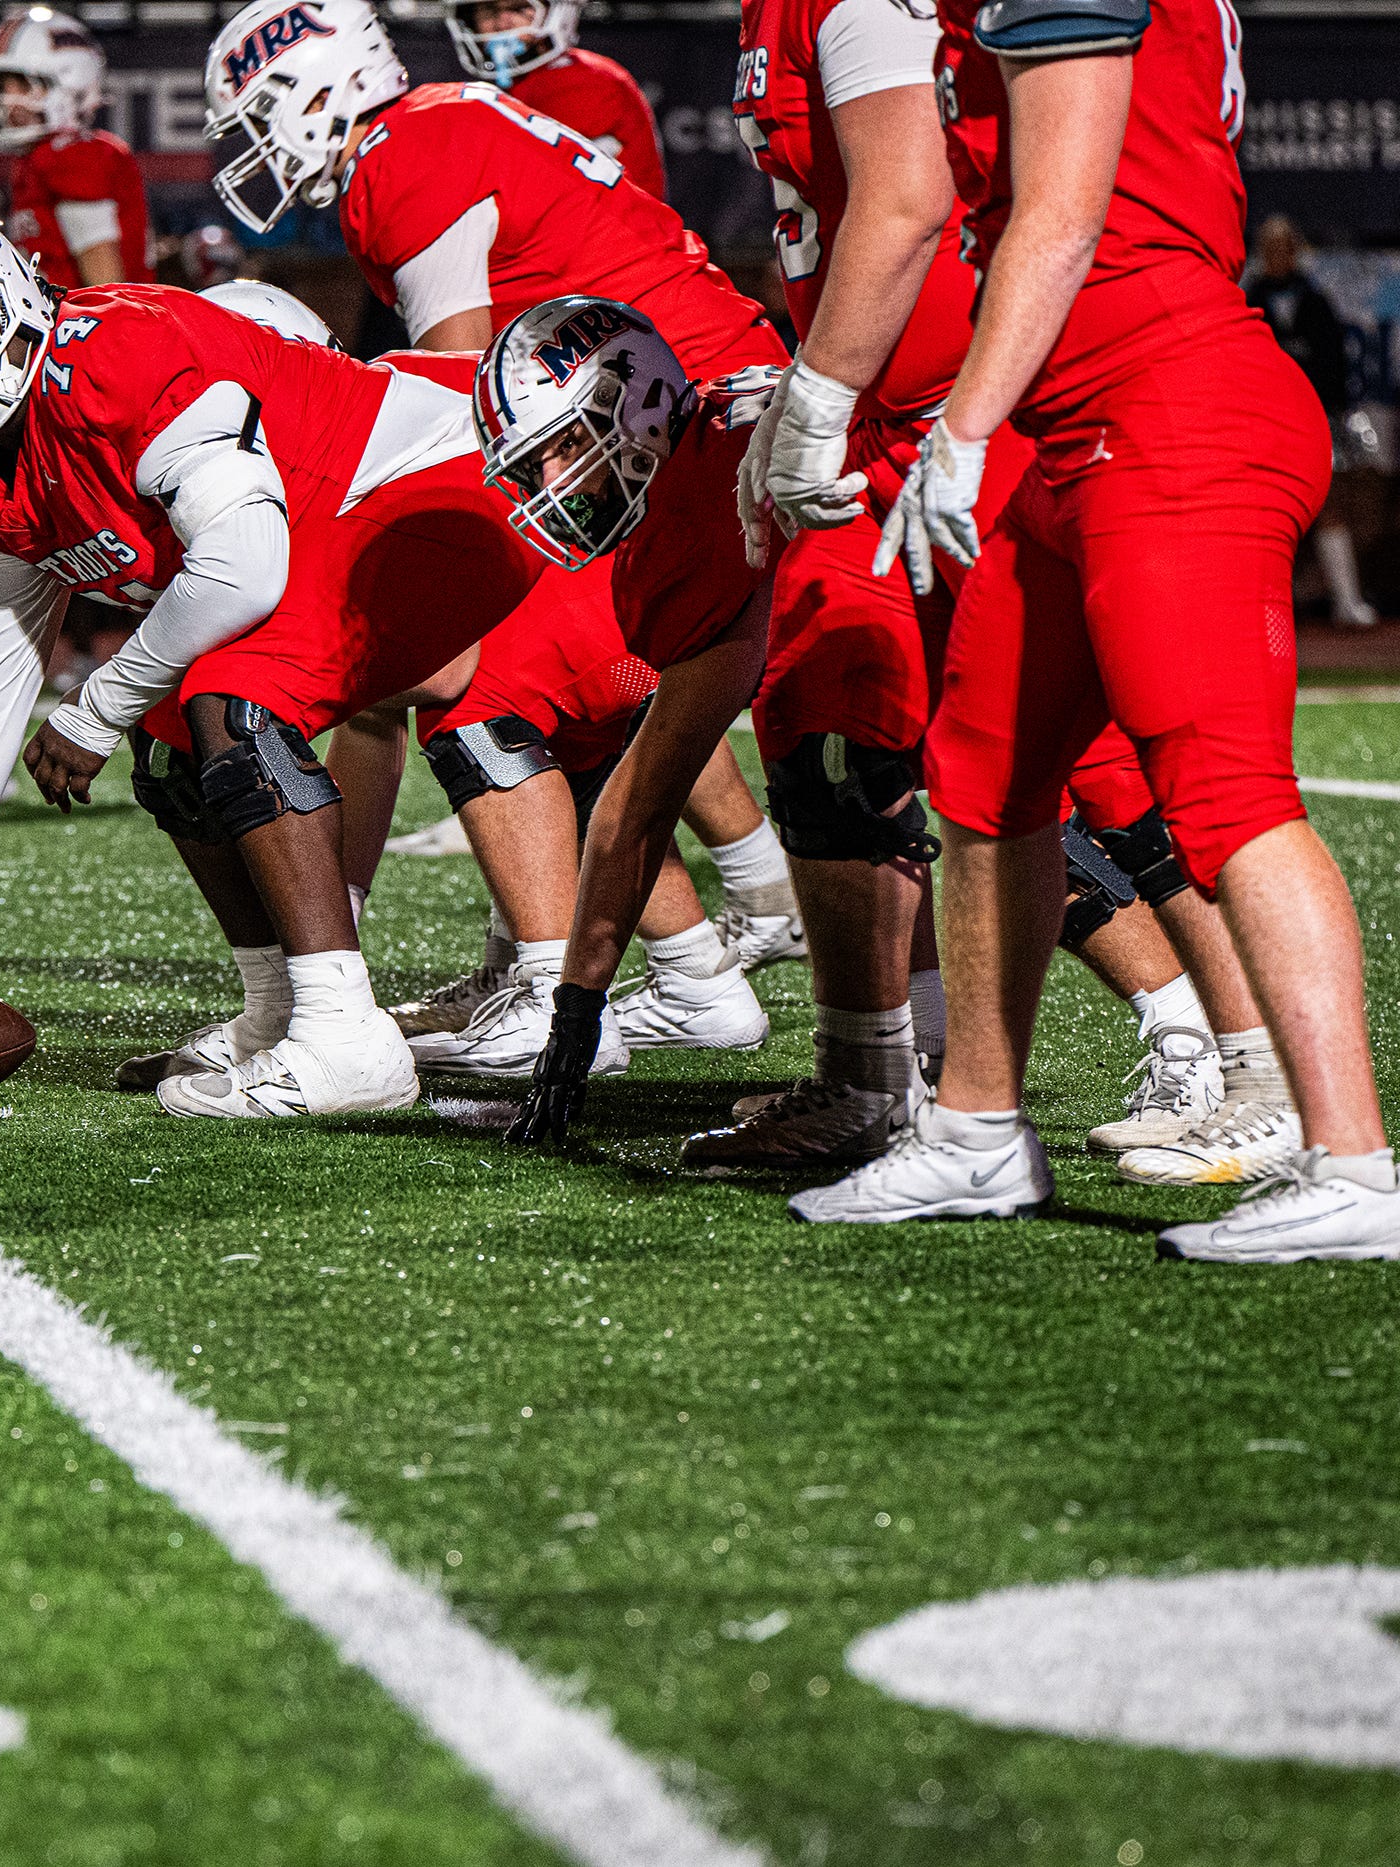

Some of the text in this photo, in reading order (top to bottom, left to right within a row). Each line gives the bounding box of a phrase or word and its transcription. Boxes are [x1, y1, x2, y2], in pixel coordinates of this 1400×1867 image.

[221, 2, 338, 97] MRA
[41, 315, 103, 397] 74
[531, 303, 653, 389] MRA
